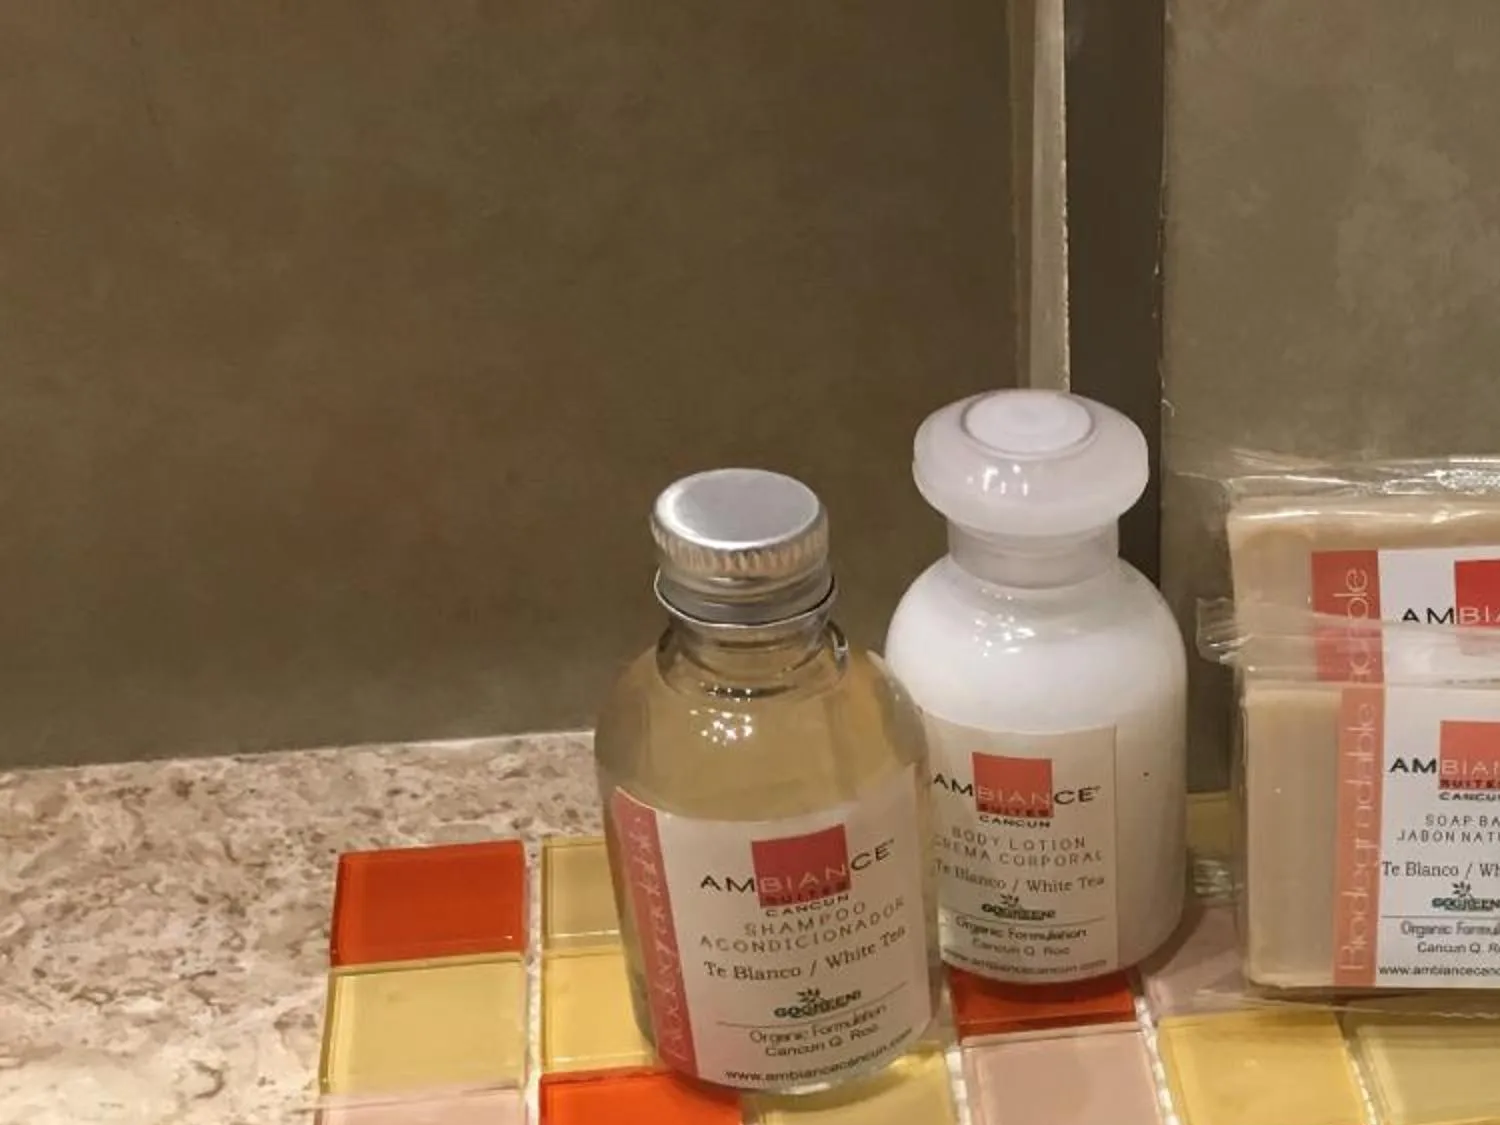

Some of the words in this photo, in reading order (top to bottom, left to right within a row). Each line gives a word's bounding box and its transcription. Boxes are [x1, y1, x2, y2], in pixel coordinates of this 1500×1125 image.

[933, 772, 1100, 806] AMBIANCE
[979, 815, 1050, 828] CANCUN
[1425, 815, 1471, 827] SOAP
[952, 827, 1000, 847] BODY
[1009, 837, 1086, 851] LOTION
[1396, 829, 1455, 842] JABON
[700, 839, 893, 894] AMBIANCE
[1382, 861, 1399, 877] Te
[1406, 861, 1459, 877] Blanco
[954, 866, 1006, 890] Blanco
[1026, 877, 1072, 893] White
[1078, 875, 1104, 888] Tea
[765, 894, 849, 917] CANCUN
[700, 896, 905, 953] ACONDICIONADOR
[744, 901, 866, 936] SHAMPOO
[1400, 920, 1450, 938] Organic
[704, 960, 727, 977] Te
[734, 964, 801, 981] Blanco
[826, 944, 876, 970] White
[880, 927, 905, 947] Tea
[1418, 943, 1466, 955] Cancun
[765, 1040, 825, 1057] Cancun
